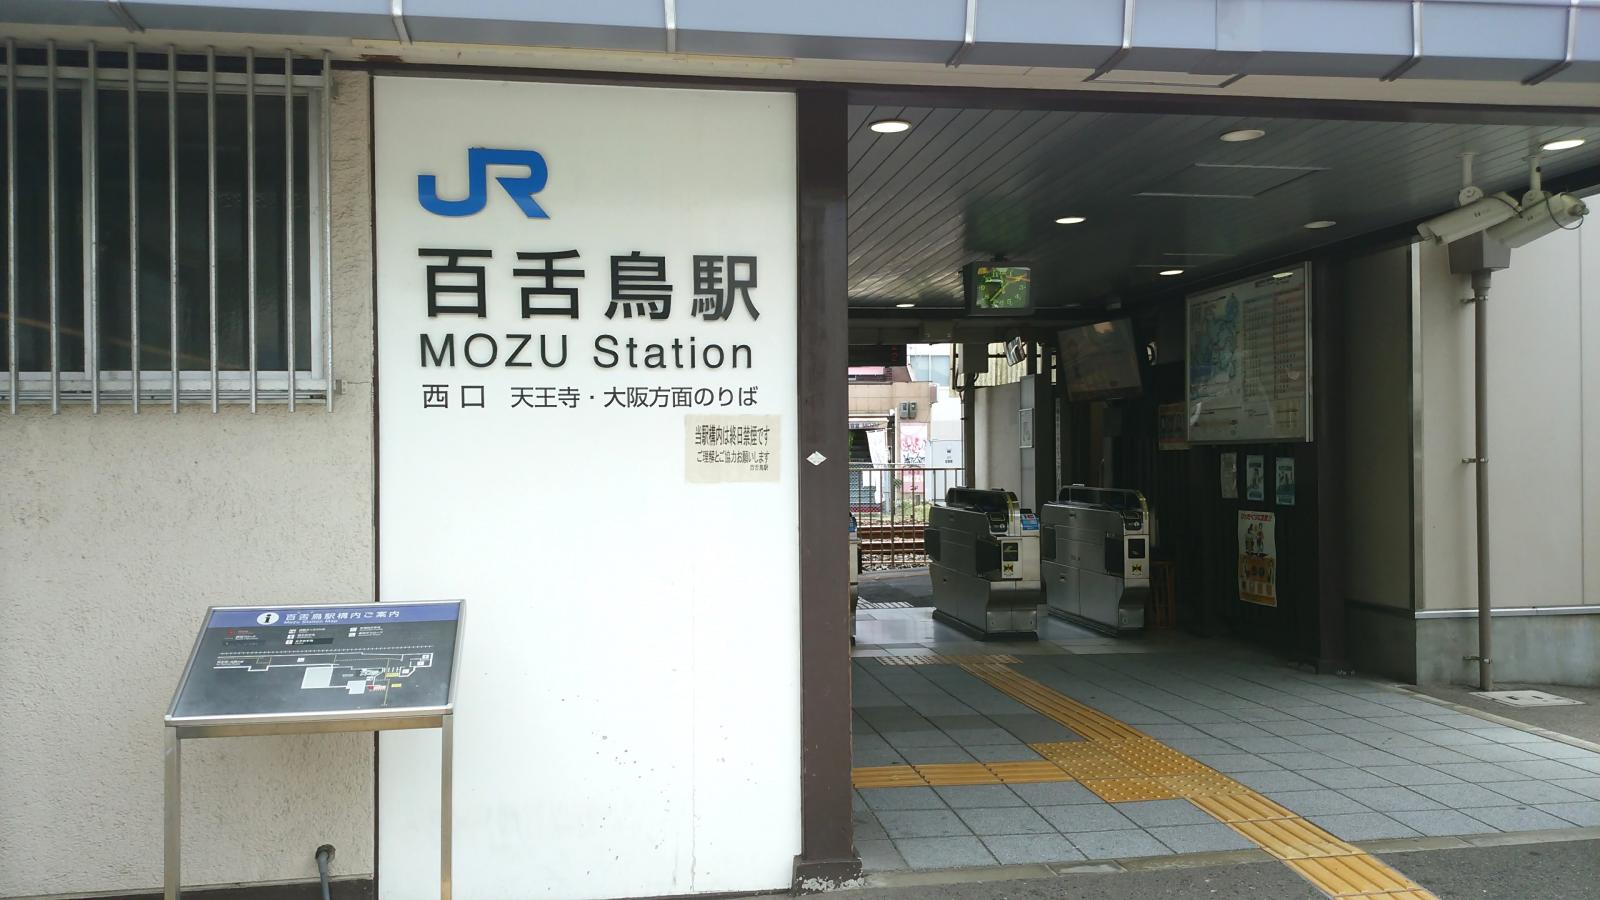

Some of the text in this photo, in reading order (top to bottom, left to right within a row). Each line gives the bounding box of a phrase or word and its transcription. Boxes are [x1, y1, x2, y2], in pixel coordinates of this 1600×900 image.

[418, 146, 550, 219] JR
[418, 248, 760, 321] 百舌鳥駅
[420, 333, 753, 369] MOZU Station
[422, 384, 486, 409] 西口
